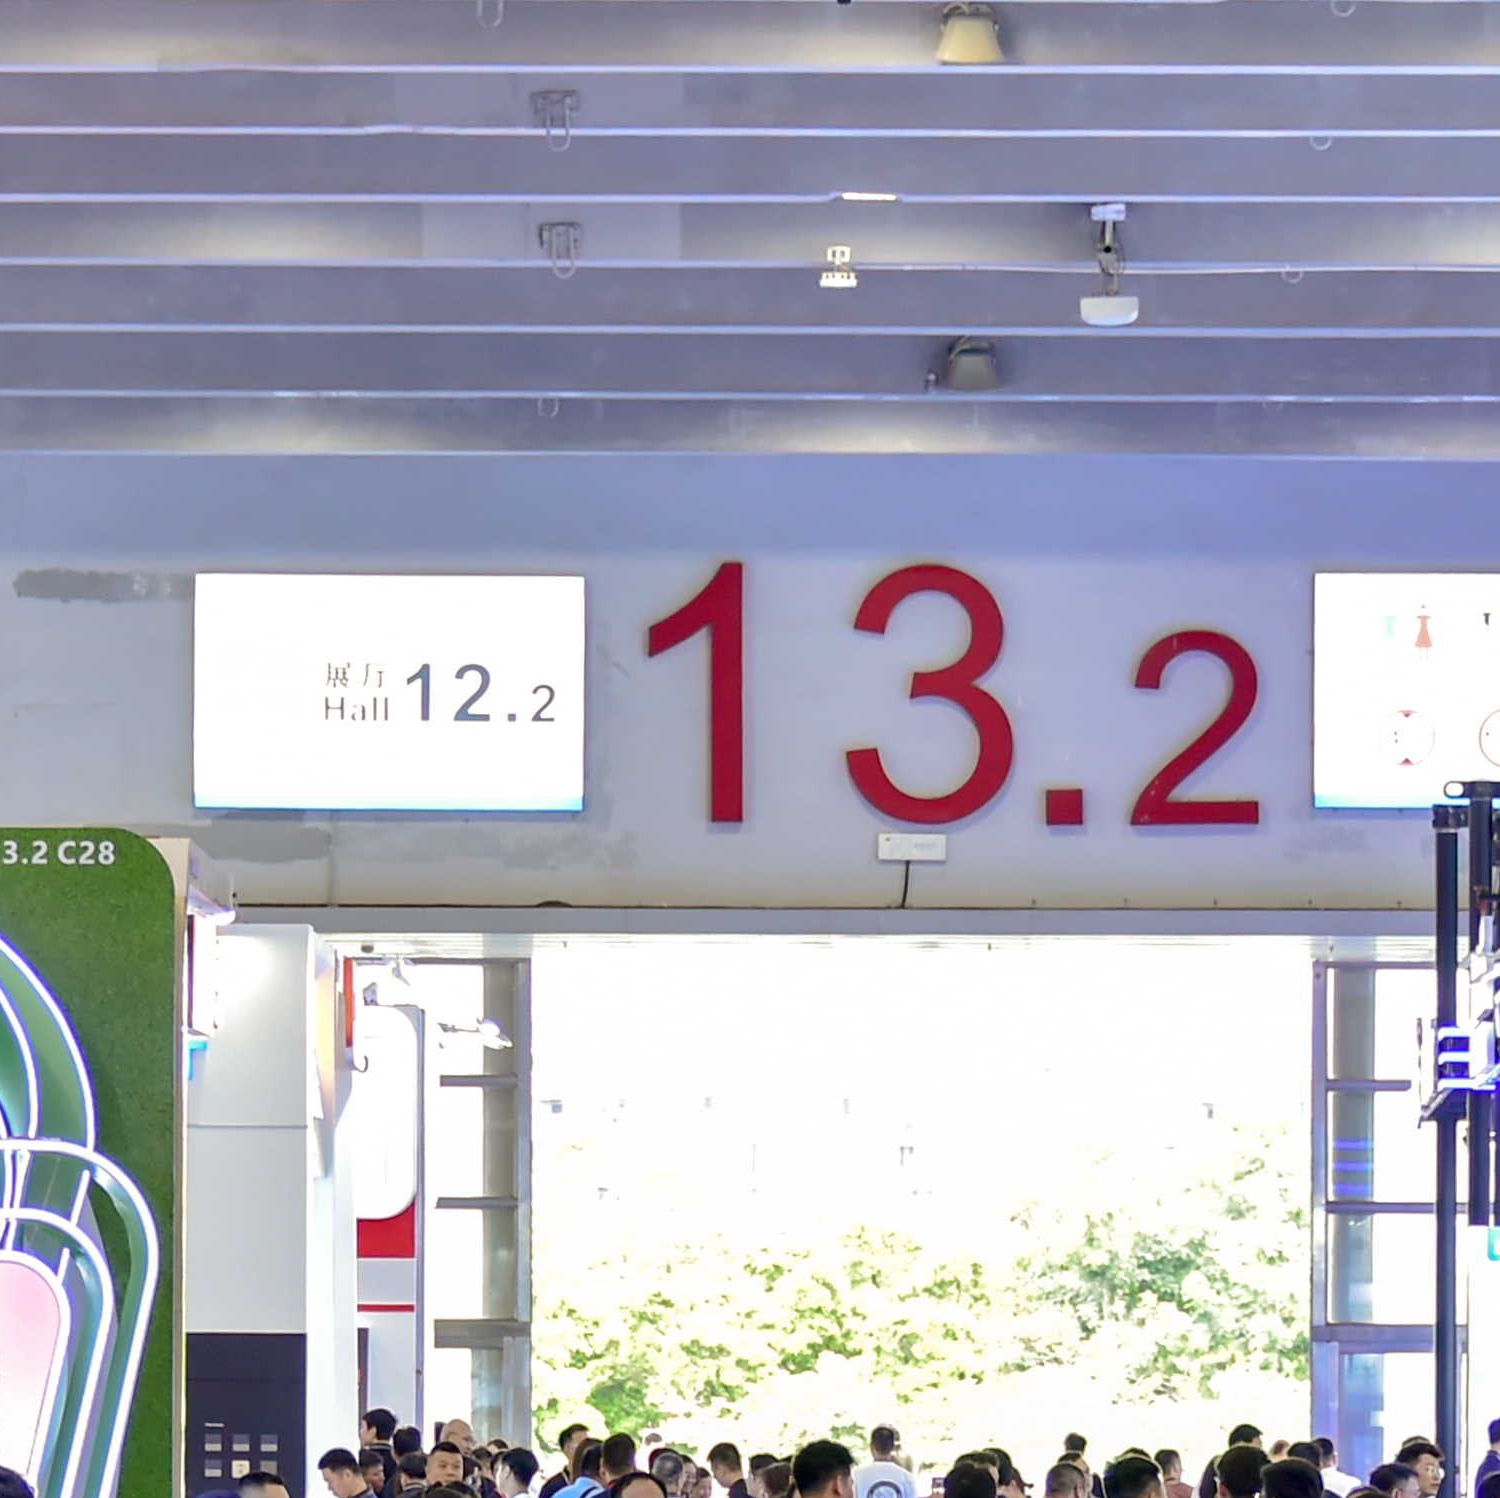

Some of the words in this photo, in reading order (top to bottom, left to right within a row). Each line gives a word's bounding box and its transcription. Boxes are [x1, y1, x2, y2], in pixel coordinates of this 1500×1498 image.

[325, 662, 387, 689] 展厅
[406, 662, 556, 723] 12.2
[647, 561, 1260, 828] 13.2
[324, 696, 389, 721] Hall
[56, 839, 117, 865] C28
